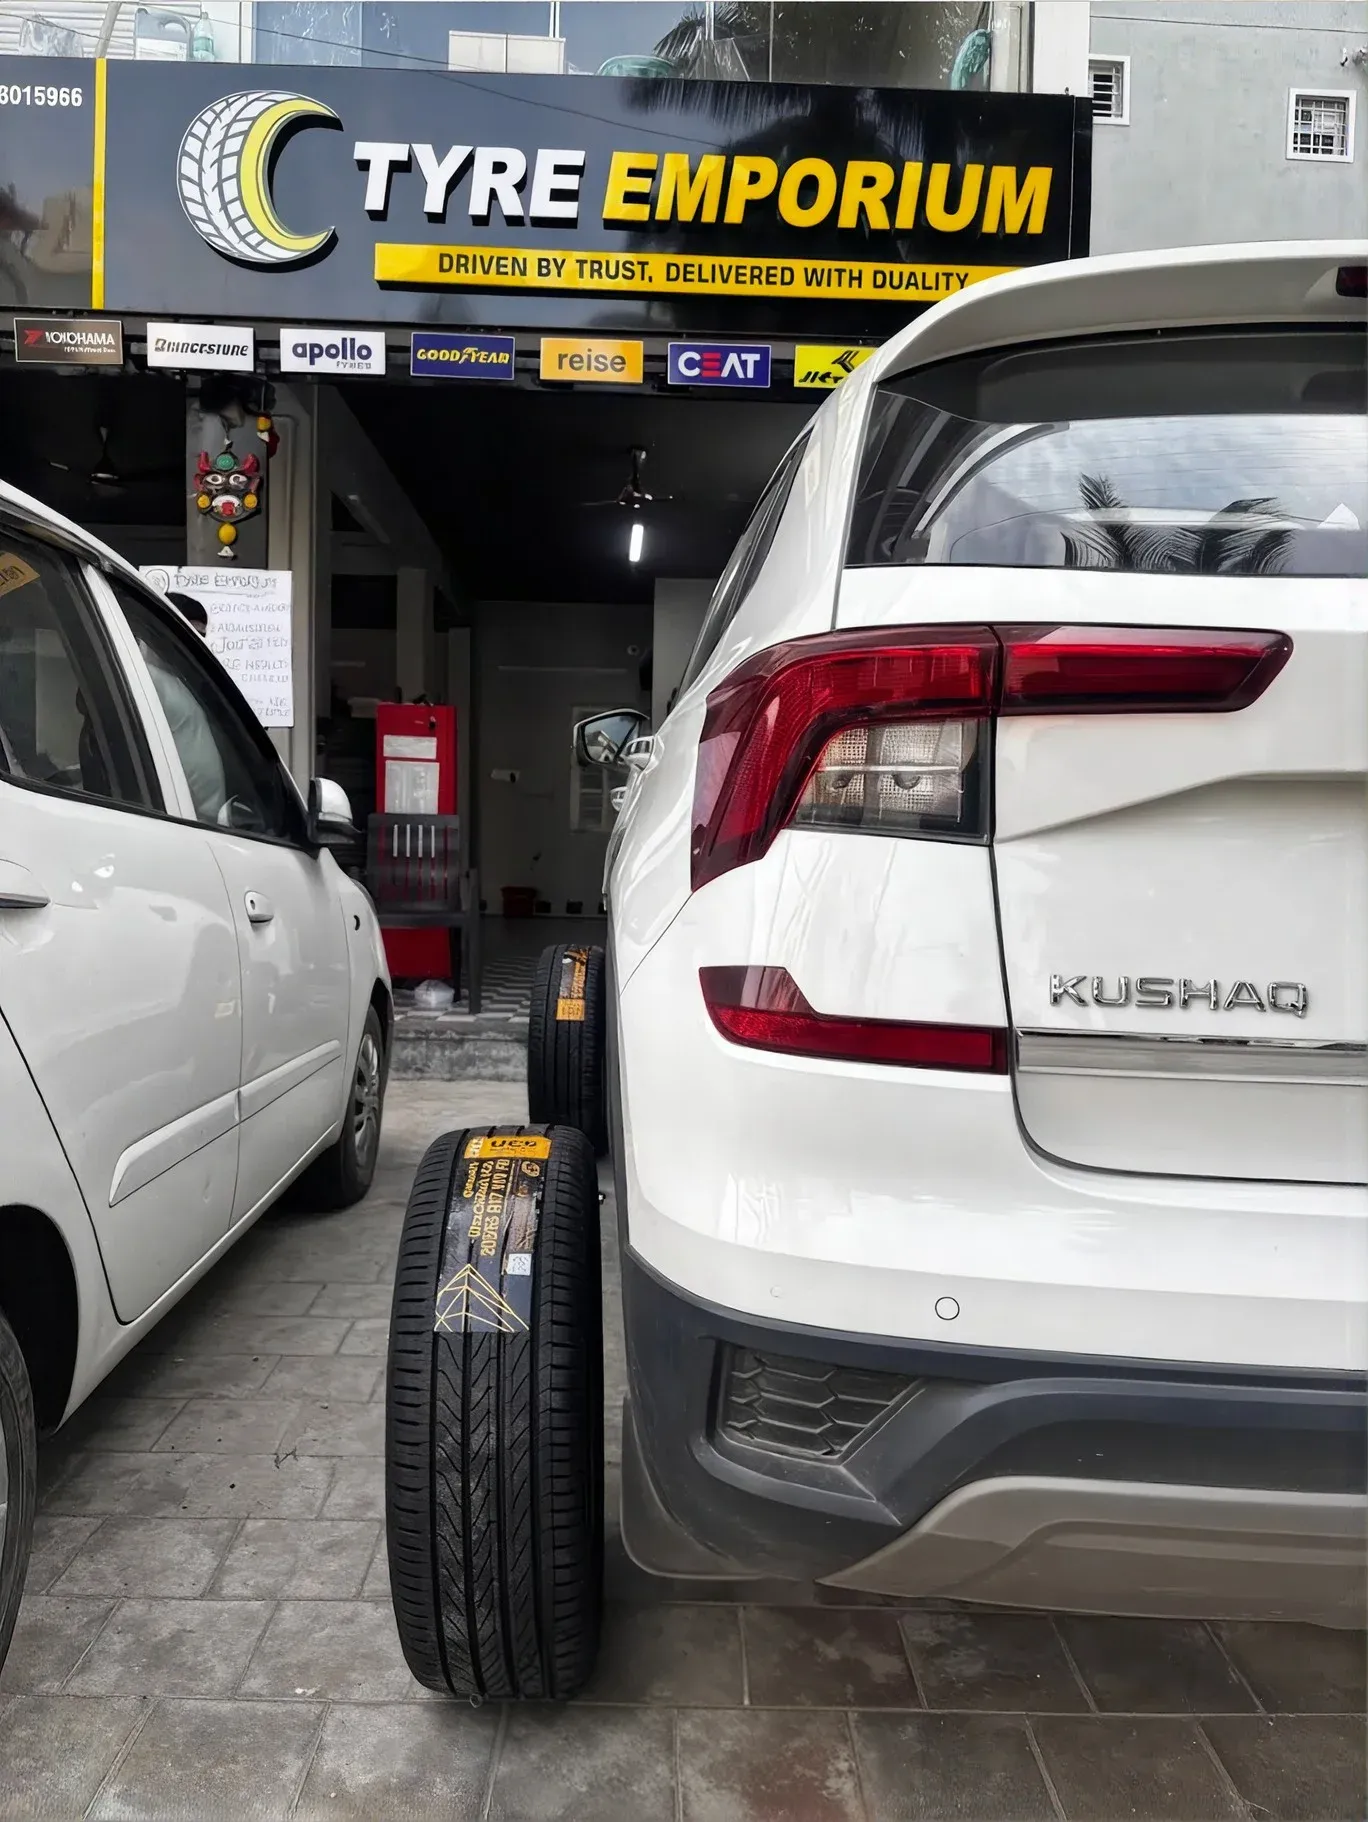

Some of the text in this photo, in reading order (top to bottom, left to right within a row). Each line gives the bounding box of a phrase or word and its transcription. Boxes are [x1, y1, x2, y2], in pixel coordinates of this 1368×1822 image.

[353, 141, 1053, 236] TYRE EMPORIUM
[438, 252, 528, 278] DRIVEN
[537, 257, 567, 279] BY
[666, 263, 796, 287] DELIVERED
[803, 267, 863, 290] WITH
[292, 337, 373, 366] apollo
[557, 348, 627, 373] reise
[678, 351, 761, 379] CEAT
[1050, 973, 1309, 1020] KUSHAQ
